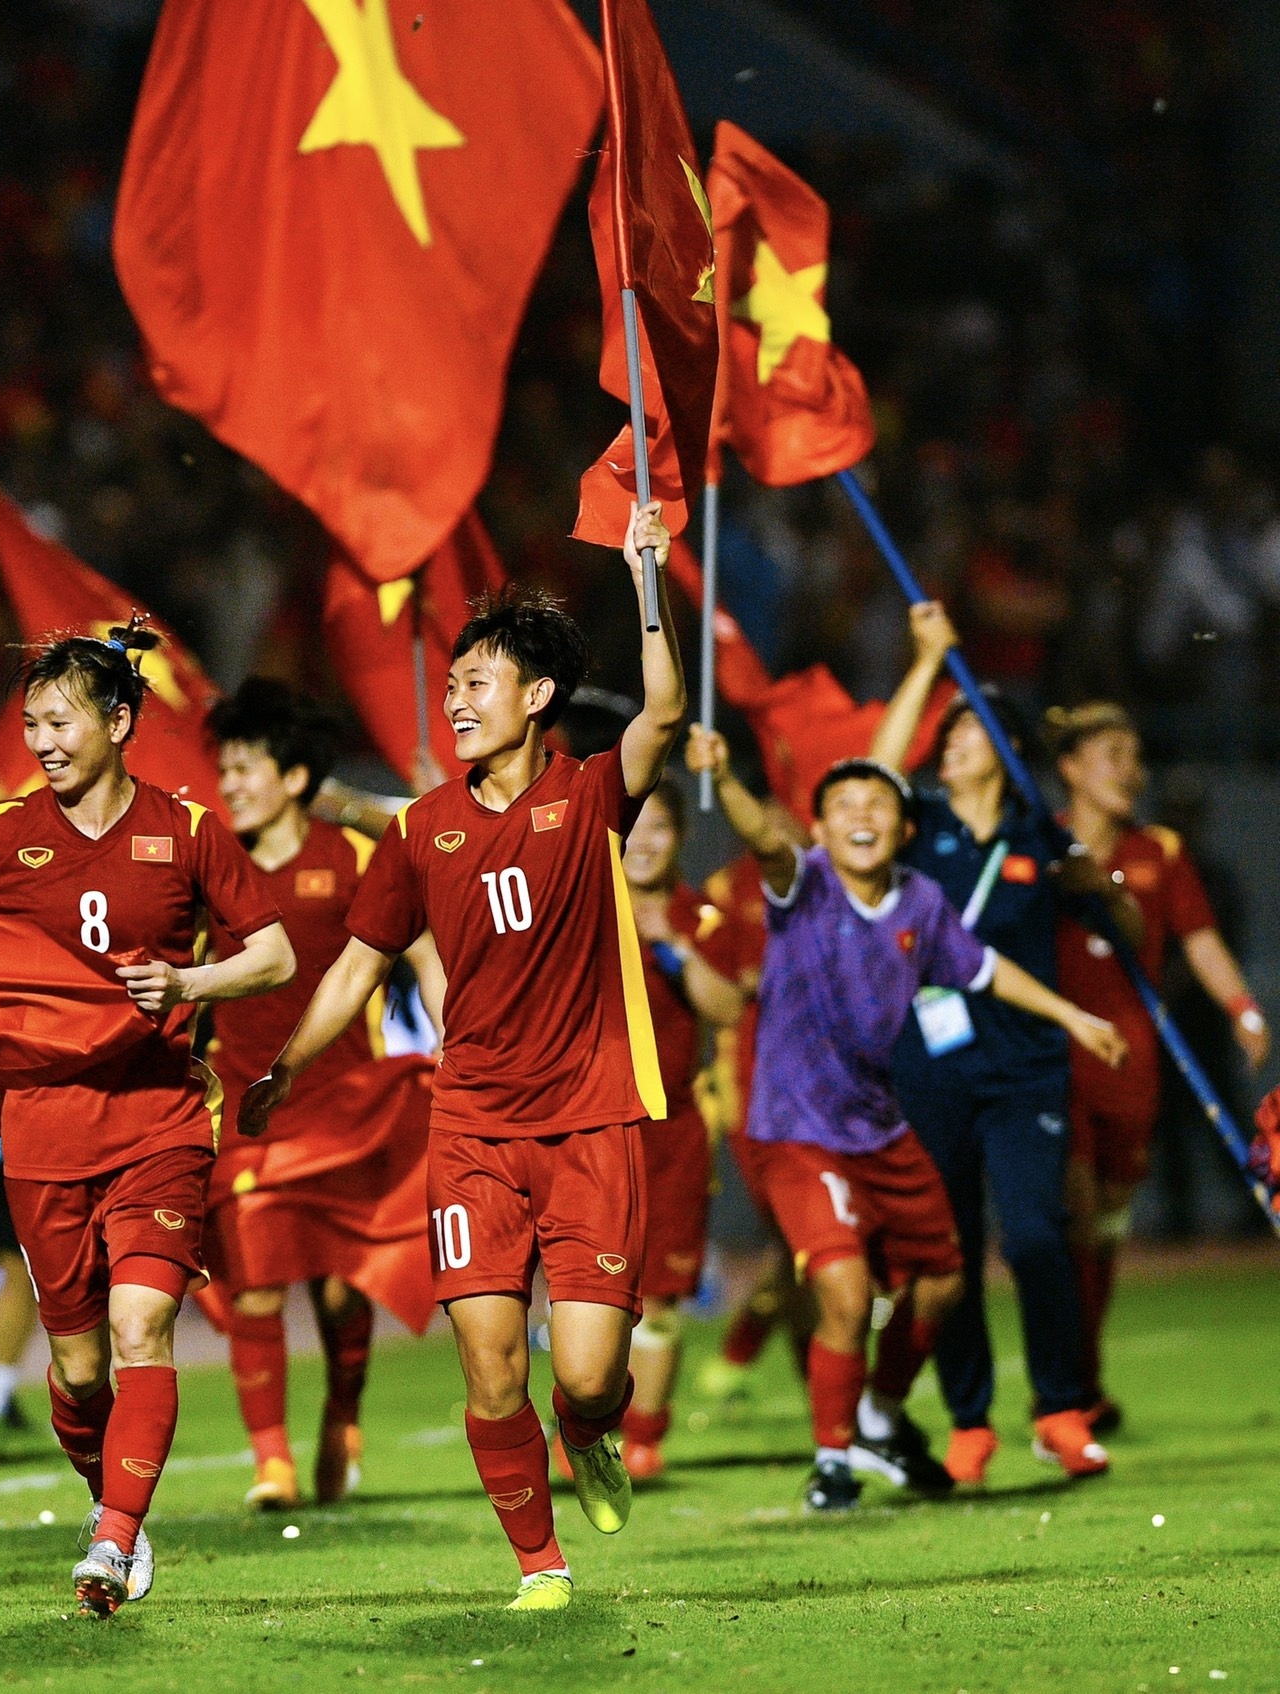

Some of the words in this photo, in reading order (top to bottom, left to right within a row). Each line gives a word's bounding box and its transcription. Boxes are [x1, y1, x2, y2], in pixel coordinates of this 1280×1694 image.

[79, 890, 111, 954] 8
[481, 866, 533, 935] 10
[432, 1203, 472, 1272] 10
